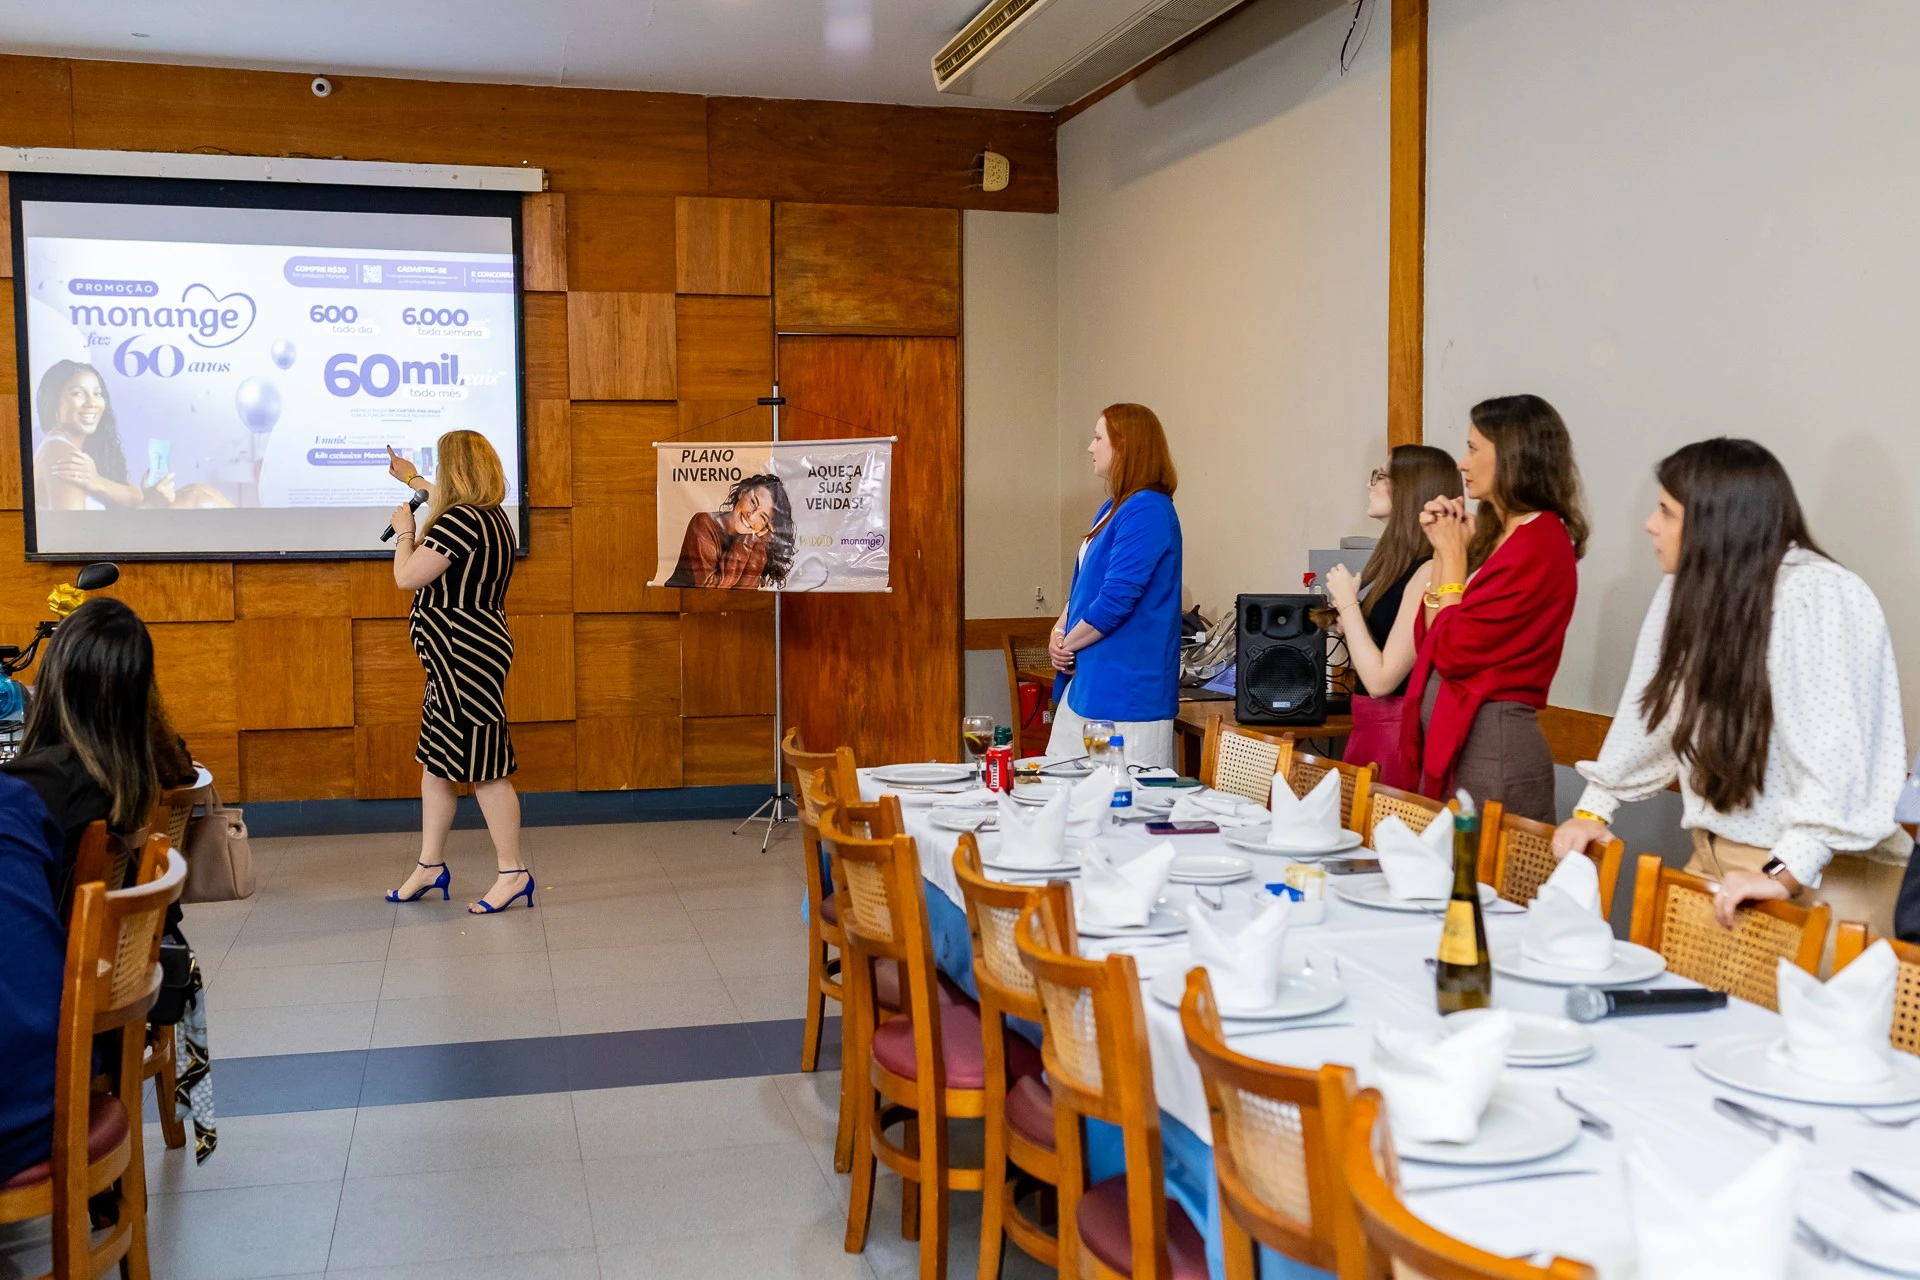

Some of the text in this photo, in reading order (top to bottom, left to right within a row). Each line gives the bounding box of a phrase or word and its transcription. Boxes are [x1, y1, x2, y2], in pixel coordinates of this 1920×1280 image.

[295, 265, 347, 274] COMPRE R$30
[397, 266, 448, 274] CADASTRE-SE
[76, 282, 154, 294] PROMOÇÃO
[310, 304, 358, 324] 600
[402, 307, 469, 326] 6.000
[69, 304, 239, 338] monange
[332, 325, 372, 334] todo dia
[418, 327, 482, 337] toda semana
[84, 330, 112, 348] faz
[113, 334, 230, 378] 60 anos
[324, 353, 400, 398] 60
[402, 353, 464, 386] mil
[410, 388, 462, 398] todo mês
[322, 435, 346, 444] mais!
[682, 450, 734, 463] PLANO
[672, 467, 742, 482] INVERNO
[808, 465, 862, 480] AQUEÇA
[818, 482, 852, 494] SUAS
[806, 497, 864, 510] VENDAS!
[800, 534, 833, 547] PAIXÃO
[841, 537, 880, 548] monange
